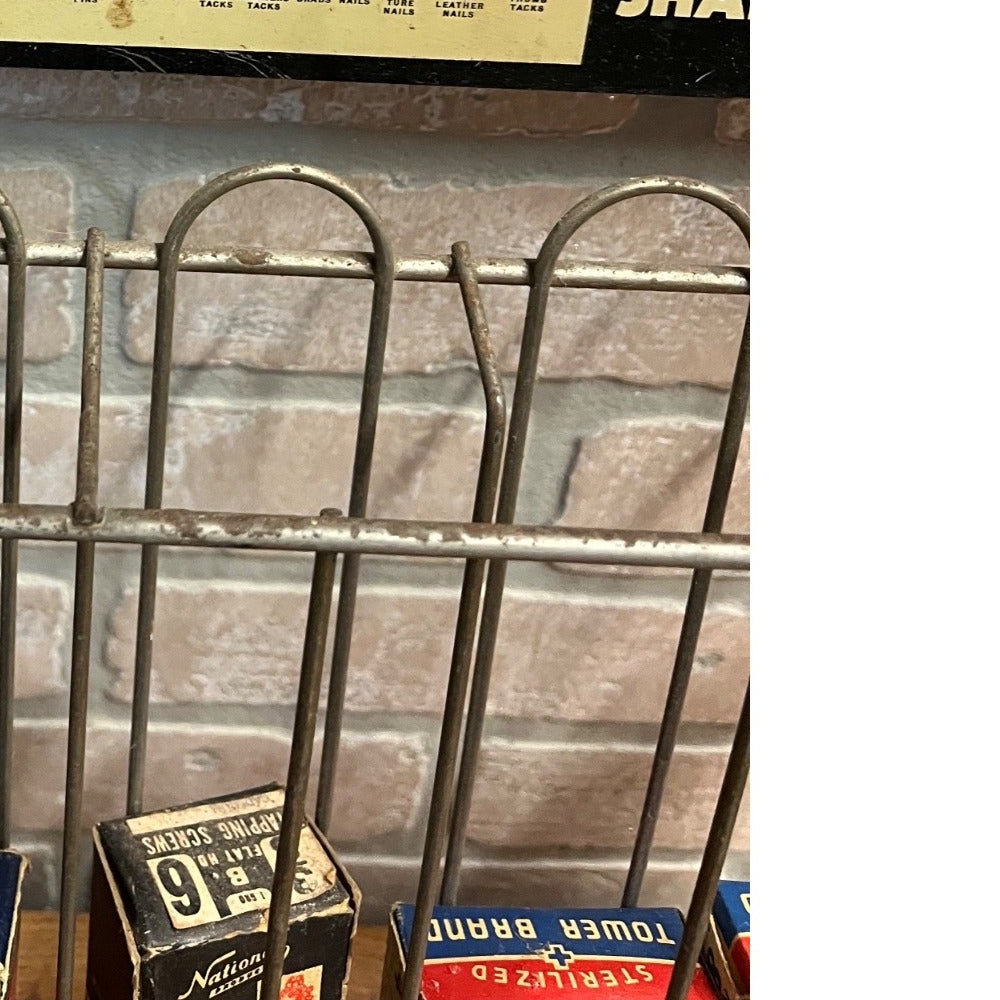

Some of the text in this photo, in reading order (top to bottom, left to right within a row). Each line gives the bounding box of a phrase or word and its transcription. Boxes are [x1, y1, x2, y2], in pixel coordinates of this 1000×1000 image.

[200, 0, 233, 9] TACKS
[247, 2, 281, 11] TACKS
[436, 1, 485, 10] LEATHER
[509, 3, 544, 13] TACKS
[383, 7, 415, 16] NAILS
[442, 10, 474, 19] NAILS
[142, 809, 283, 855] APPING SCREWS
[224, 843, 263, 863] FLAT
[156, 857, 202, 917] 6
[238, 893, 256, 904] GRO
[563, 918, 676, 945] TOWER
[471, 964, 654, 989] STERILIZED
